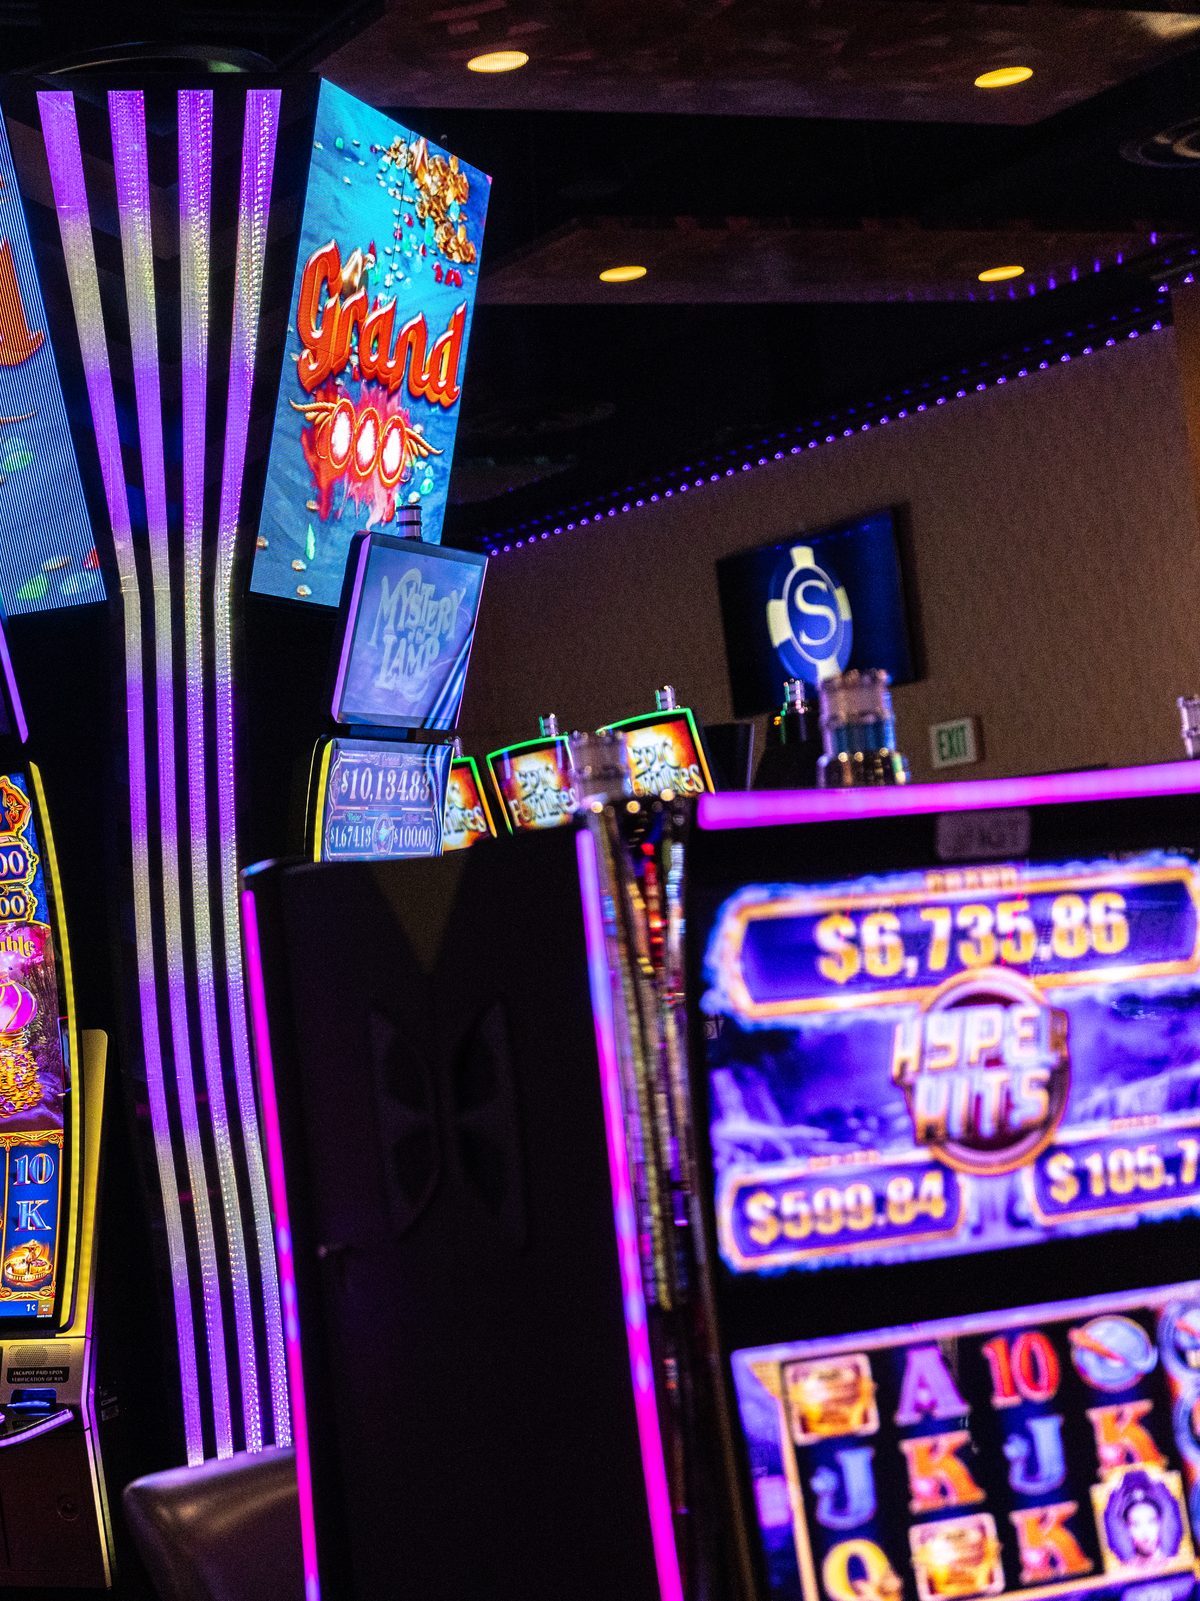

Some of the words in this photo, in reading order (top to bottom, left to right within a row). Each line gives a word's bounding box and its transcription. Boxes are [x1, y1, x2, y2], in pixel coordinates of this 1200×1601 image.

[297, 239, 468, 409] Grand
[794, 578, 838, 646] S
[936, 723, 969, 762] EXIT
[341, 766, 430, 801] $10,134.83
[394, 825, 432, 847] $100.00
[814, 890, 1131, 984] $6,735.86
[892, 1002, 1046, 1084] HYPE
[914, 1066, 1051, 1146] HITS
[14, 1152, 55, 1187] 10
[14, 1199, 52, 1232] K
[746, 1171, 946, 1246] $599.84
[895, 1346, 970, 1426] A
[982, 1331, 1060, 1410] 10
[809, 1446, 875, 1530] J
[900, 1430, 986, 1514] K
[1003, 1414, 1066, 1496] J
[1086, 1399, 1169, 1477] K
[822, 1538, 900, 1601] Q
[1009, 1500, 1093, 1584] K
